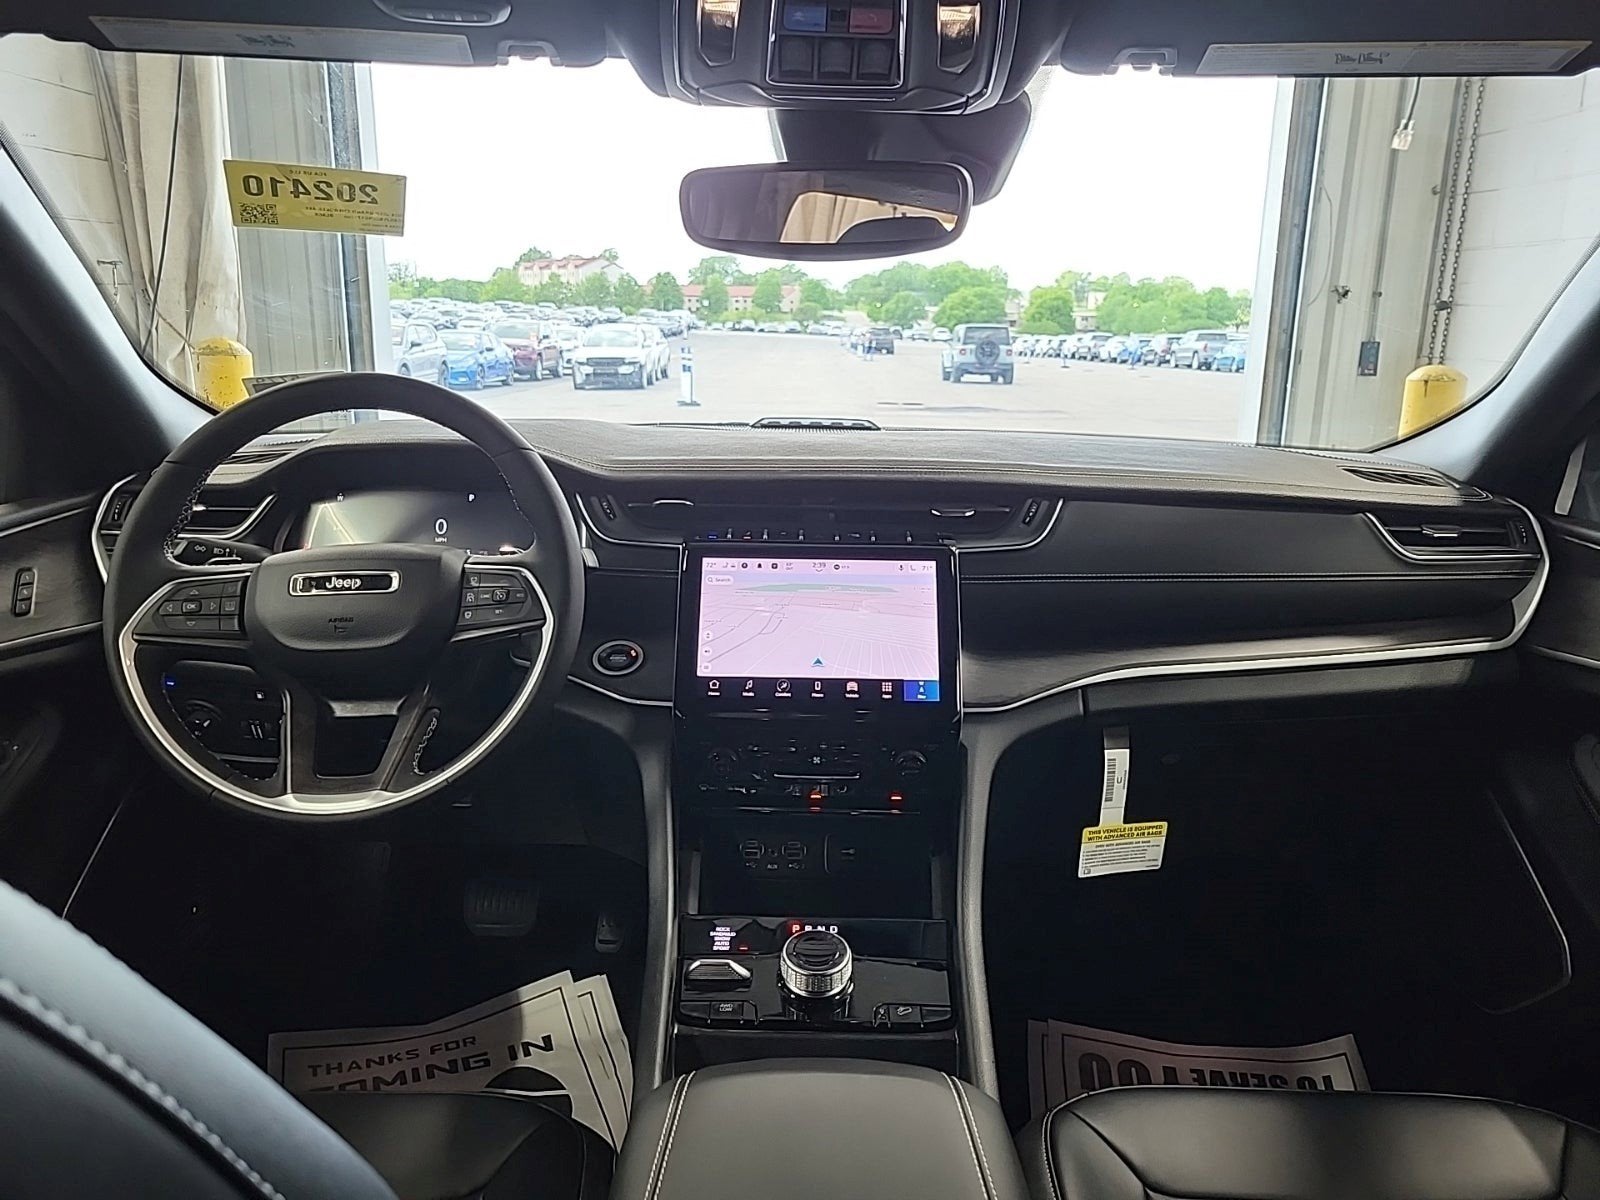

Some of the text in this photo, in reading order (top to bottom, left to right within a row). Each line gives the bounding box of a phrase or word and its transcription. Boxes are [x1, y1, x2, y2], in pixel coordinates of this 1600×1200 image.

[468, 494, 476, 502] P
[435, 518, 448, 535] 0
[325, 576, 362, 589] Jeep
[1103, 832, 1135, 840] ADVANCED
[791, 924, 801, 933] P
[829, 925, 839, 934] D
[307, 1035, 478, 1078] THANKS FOR
[307, 1033, 556, 1091] OMING IN
